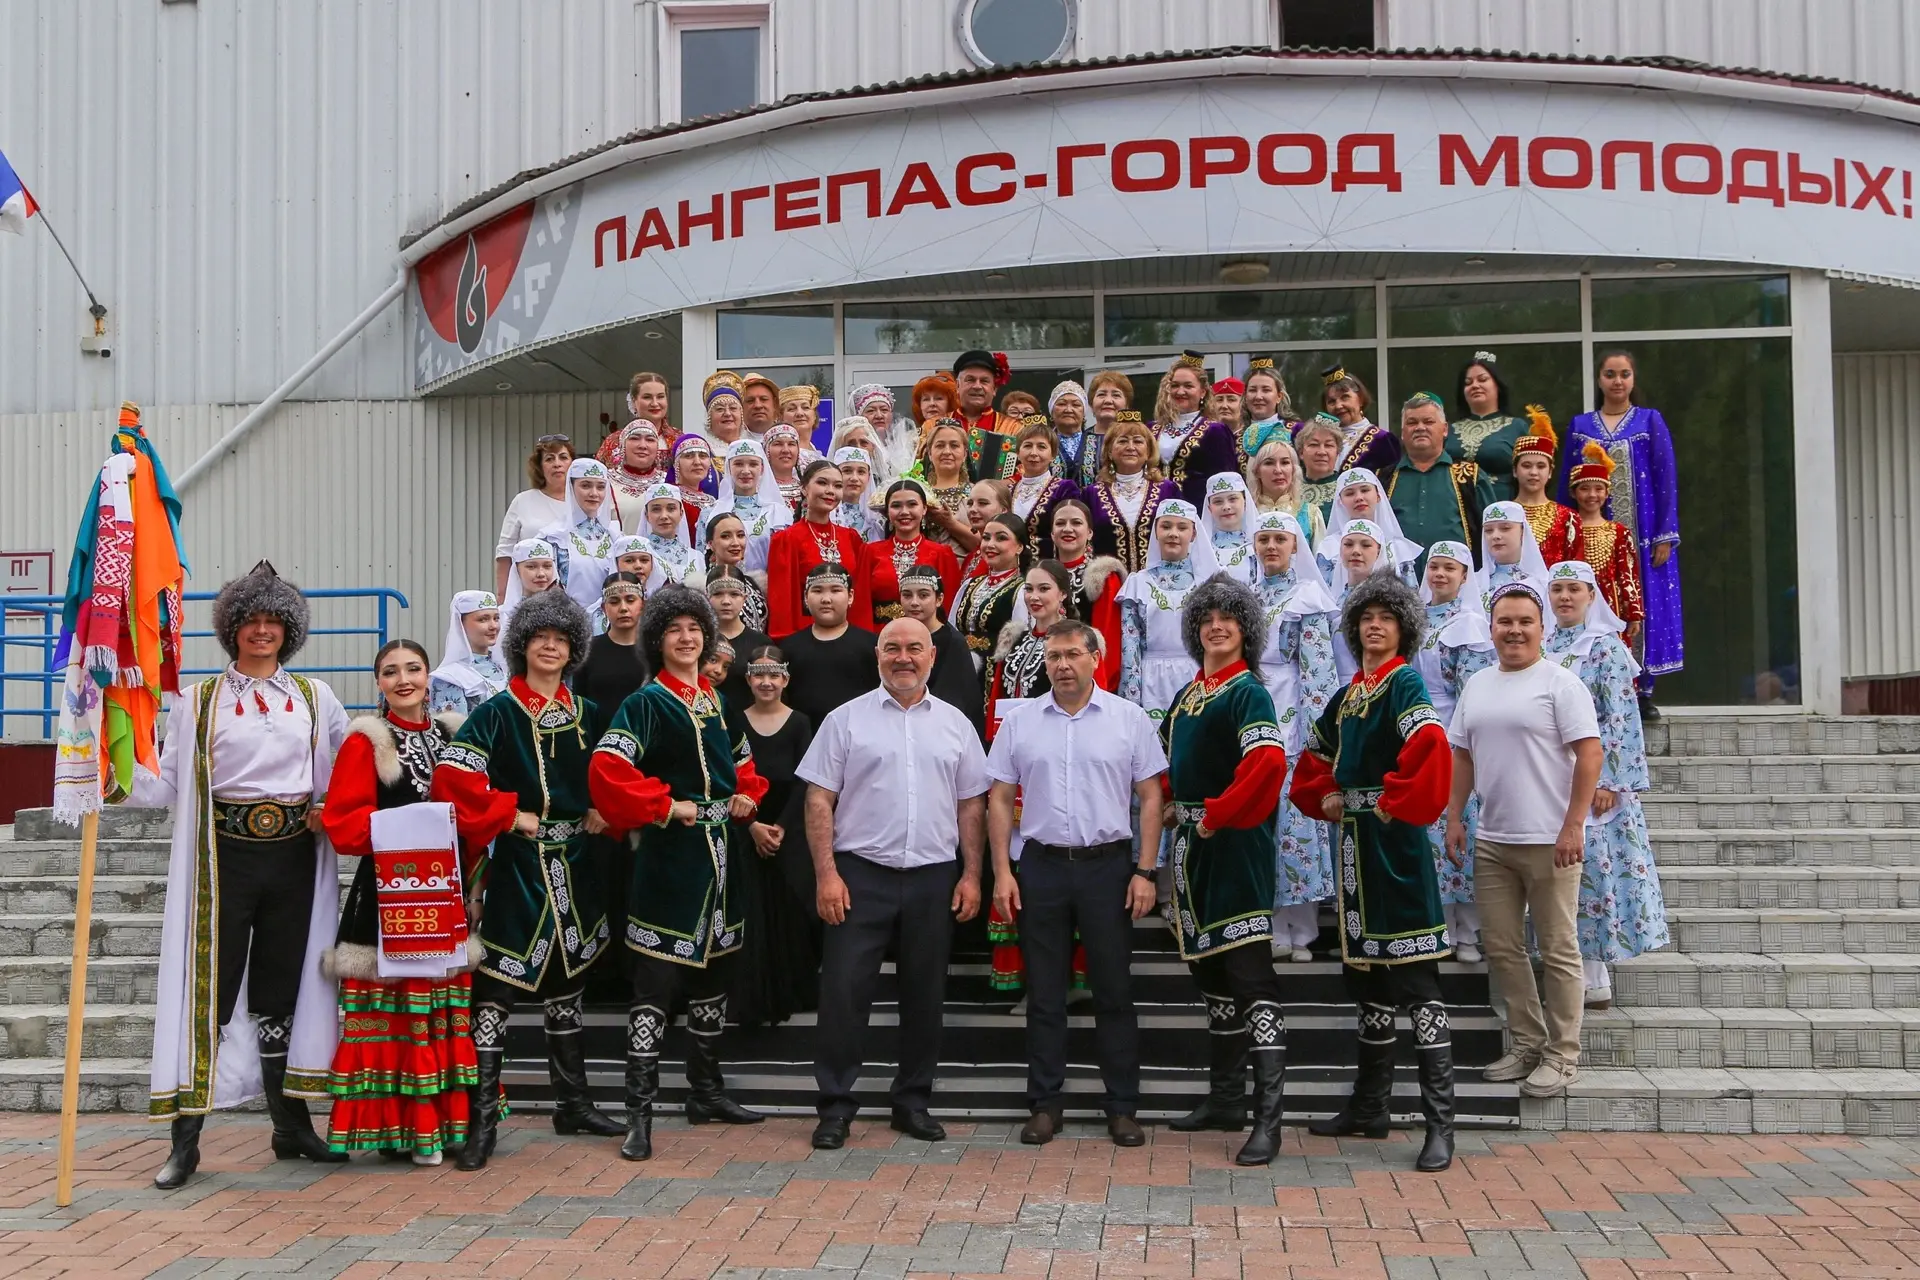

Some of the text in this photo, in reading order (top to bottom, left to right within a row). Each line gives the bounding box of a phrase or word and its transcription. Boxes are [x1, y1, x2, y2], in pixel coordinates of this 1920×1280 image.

[594, 133, 1913, 268] ЛАНГЕПАС-ГОРОД МОЛОДЫХ!
[11, 559, 33, 576] ПГ
